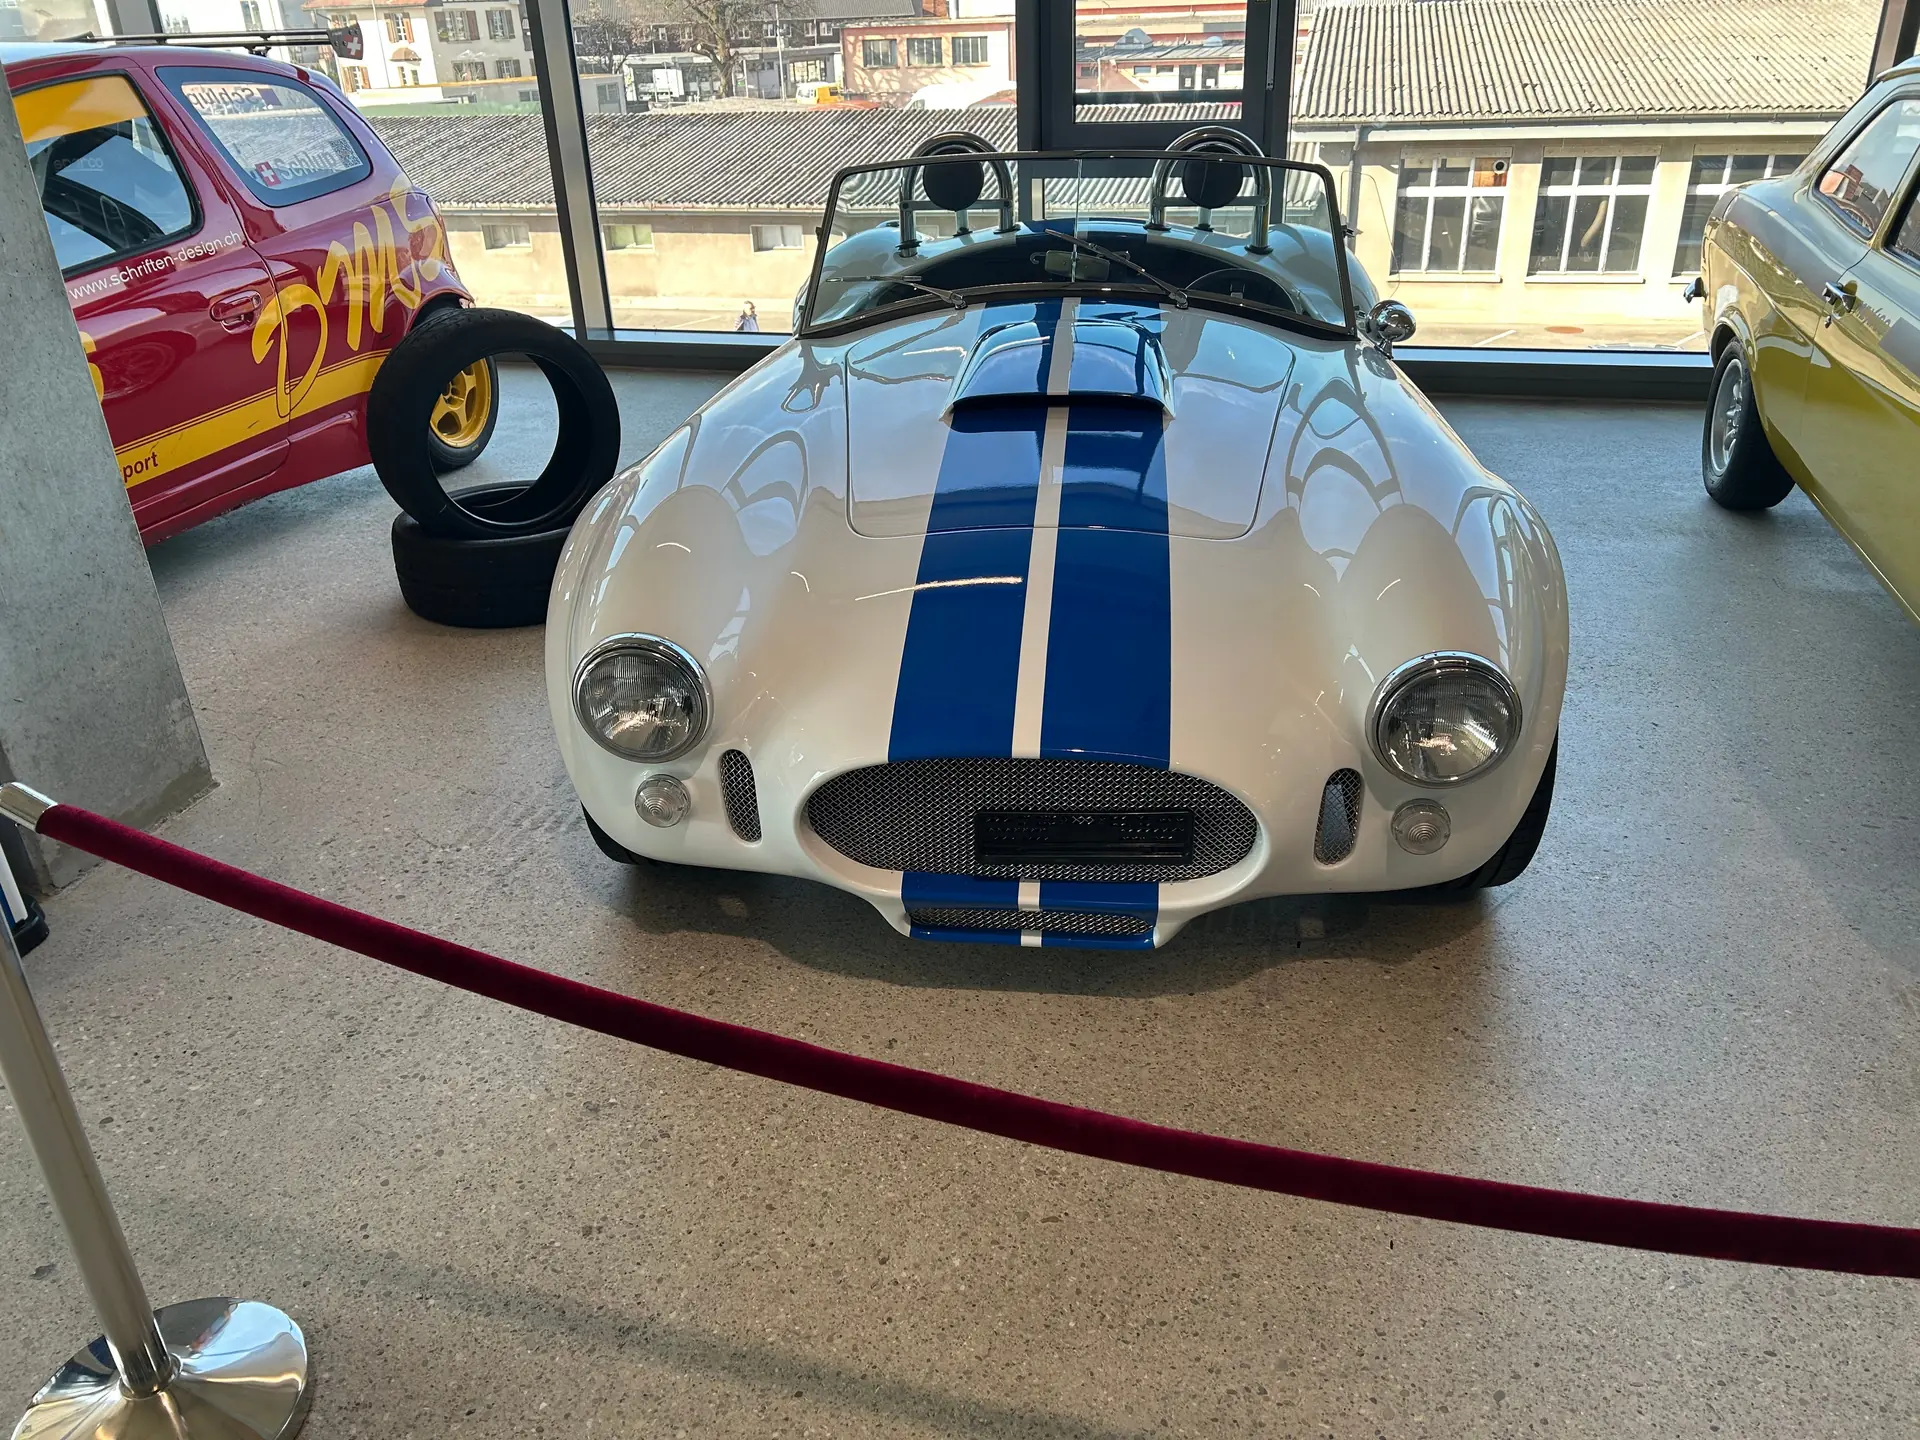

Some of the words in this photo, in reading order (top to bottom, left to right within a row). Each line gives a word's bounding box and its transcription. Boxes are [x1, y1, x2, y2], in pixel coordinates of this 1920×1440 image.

[274, 151, 340, 180] Schlup
[69, 231, 241, 300] www.schriften-design.ch
[120, 451, 158, 483] port
